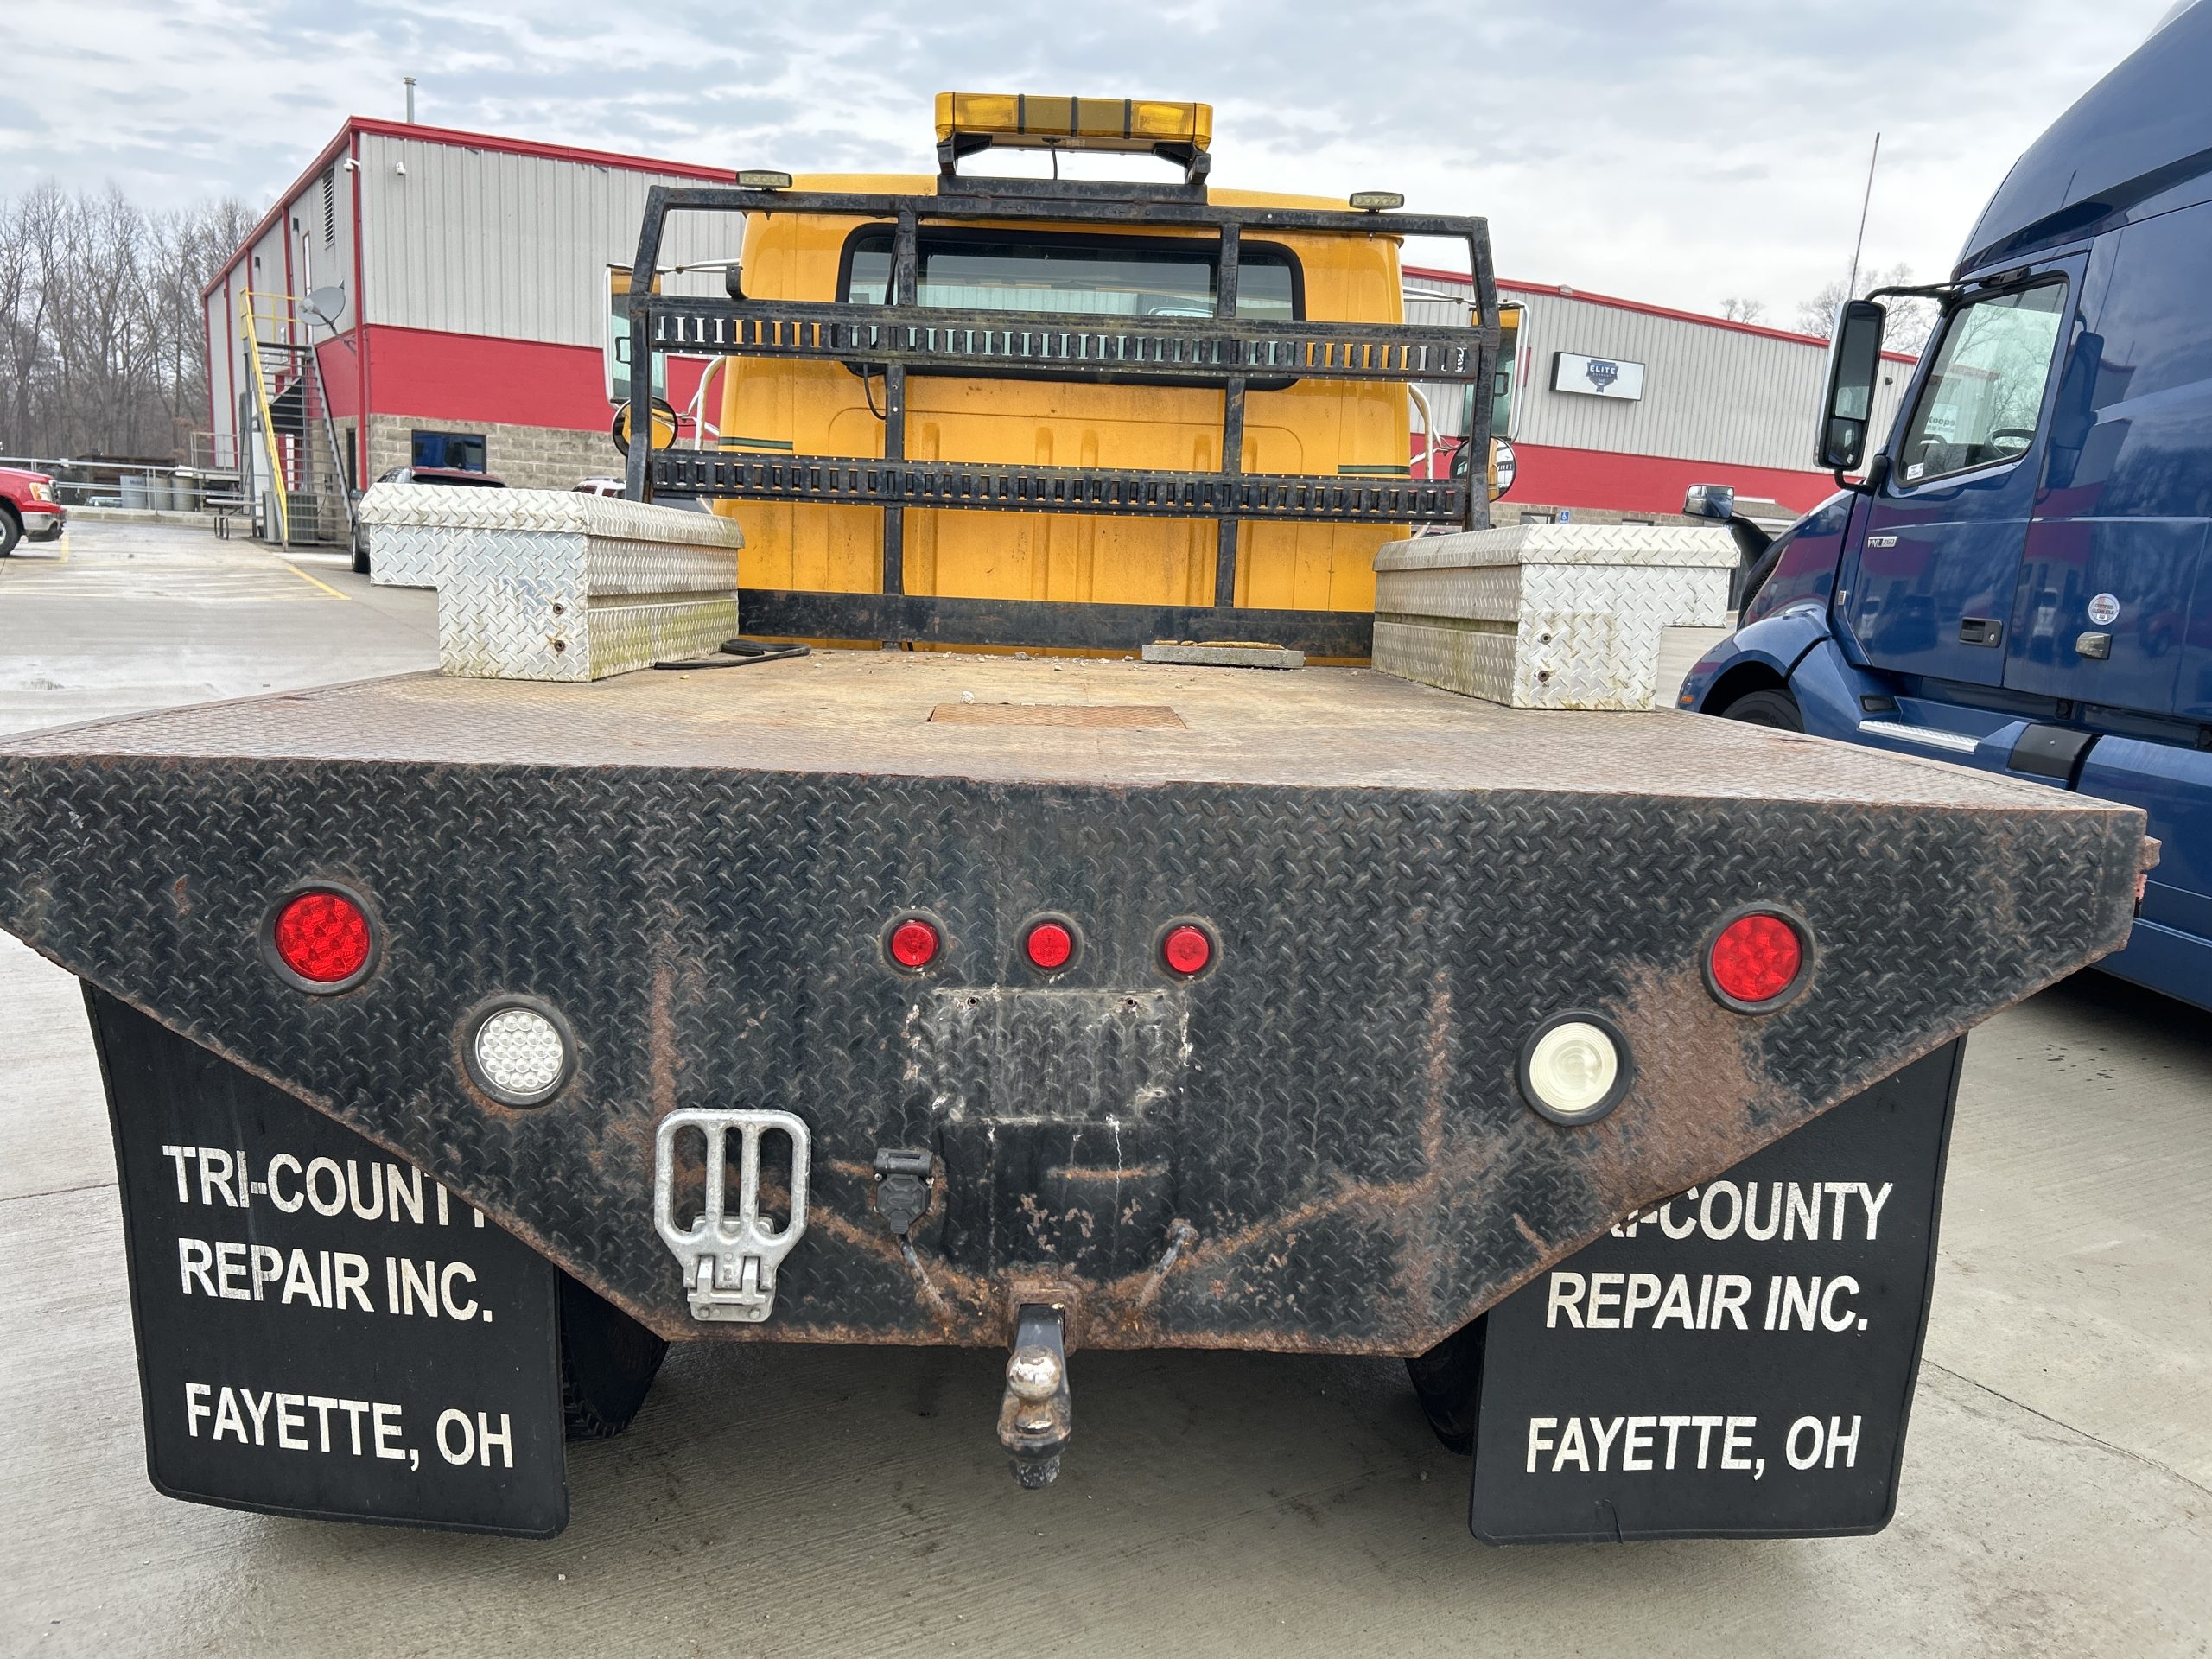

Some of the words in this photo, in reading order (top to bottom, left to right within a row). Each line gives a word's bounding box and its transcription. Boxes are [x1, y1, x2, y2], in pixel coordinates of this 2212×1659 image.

[1590, 365, 1616, 374] ELITE
[1610, 1181, 1893, 1242] -COUNTY
[178, 1238, 375, 1313] REPAIR
[385, 1256, 493, 1323] INC.
[1546, 1272, 1752, 1331] REPAIR
[1764, 1274, 1868, 1332] INC.
[185, 1382, 421, 1473] FAYETTE,
[435, 1408, 513, 1470] OH
[1526, 1415, 1765, 1481] FAYETTE,
[1785, 1415, 1862, 1471] OH
